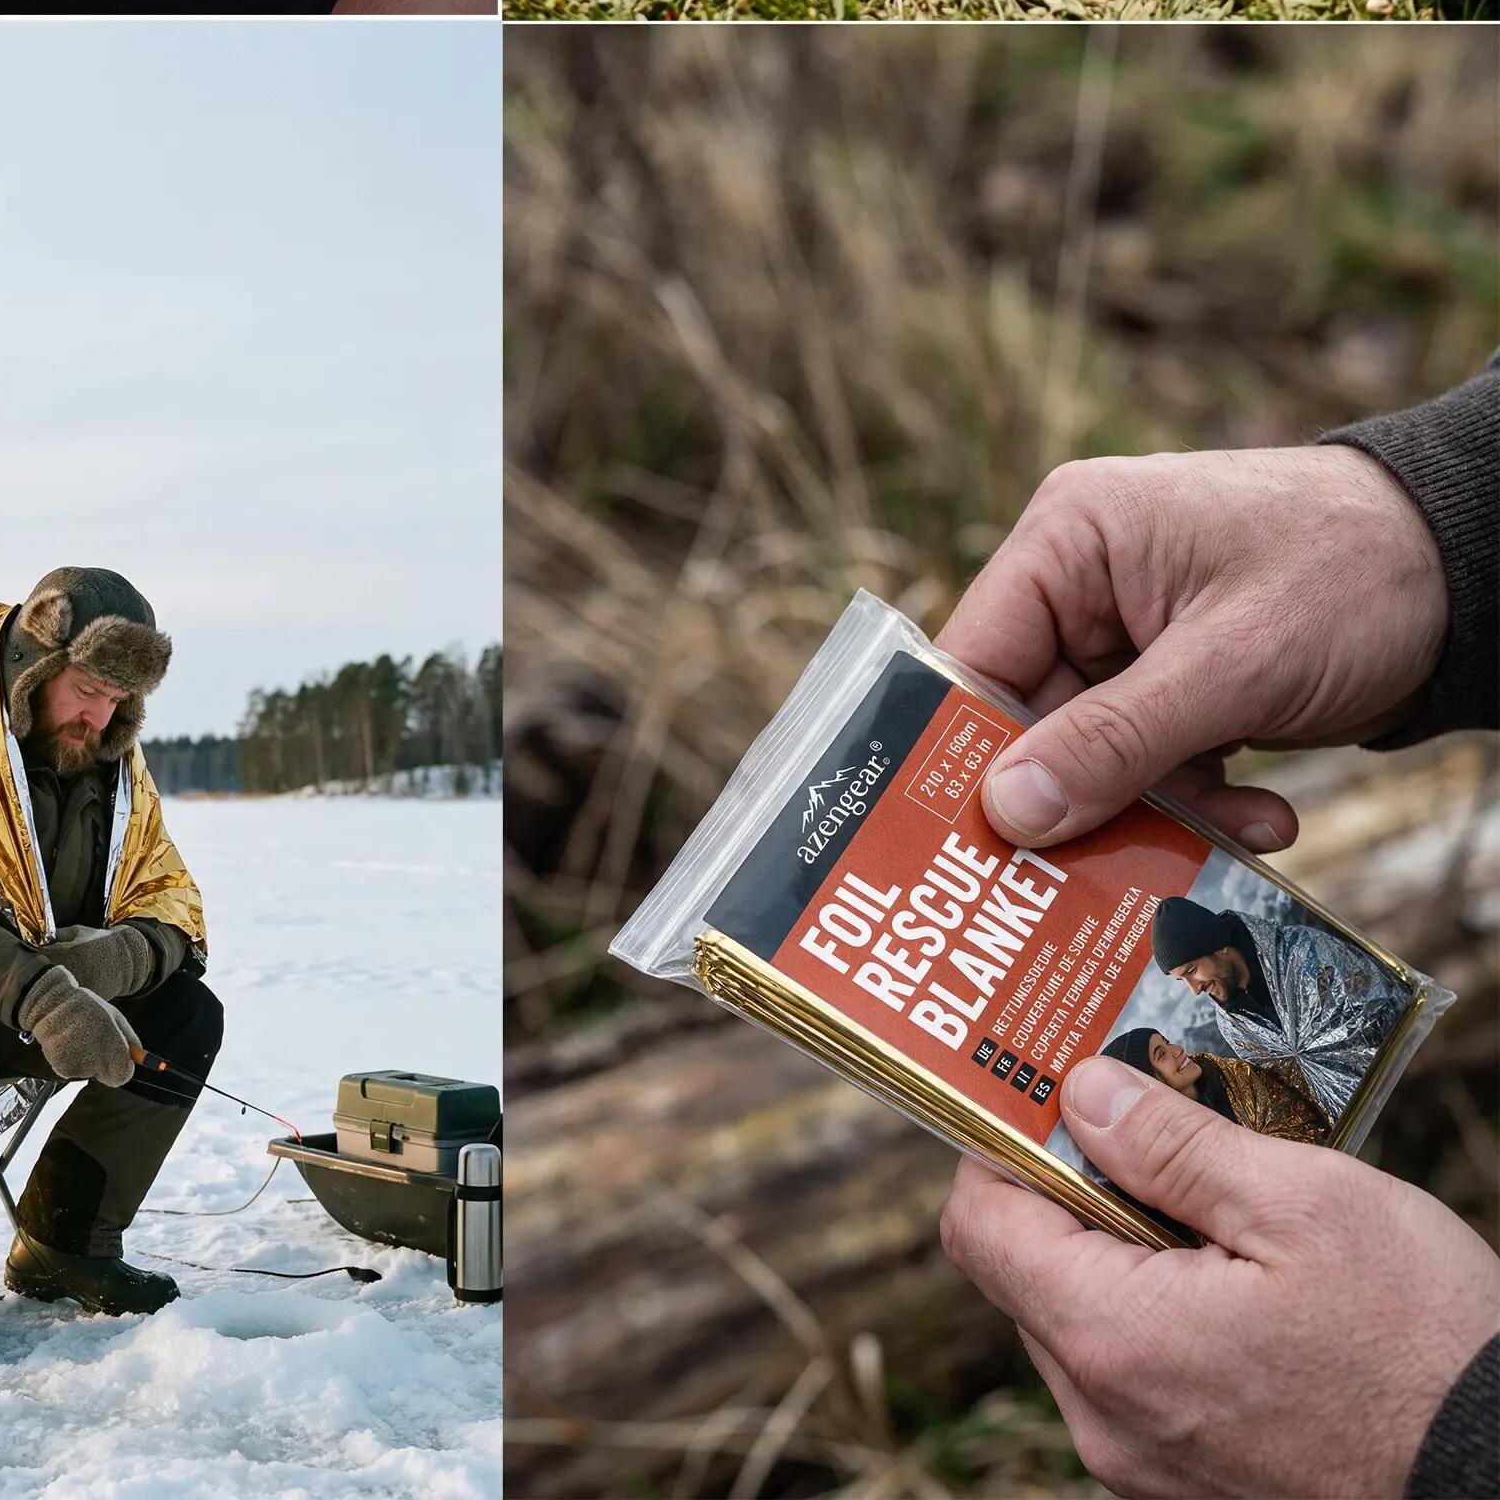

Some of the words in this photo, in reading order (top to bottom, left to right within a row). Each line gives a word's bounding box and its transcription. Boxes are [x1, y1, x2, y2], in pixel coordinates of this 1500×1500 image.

[919, 768, 943, 799] 210
[940, 758, 953, 772] x
[959, 768, 972, 780] x
[799, 871, 903, 975] FOIL
[851, 831, 1000, 1013] RESCUE
[907, 847, 1069, 1052] BLANKET
[1058, 953, 1076, 973] DE
[1068, 915, 1099, 957] SURVIE
[977, 1043, 994, 1061] DE
[1030, 1007, 1070, 1061] COPERTA
[1034, 1081, 1051, 1098] ES
[1049, 1031, 1083, 1074] MANTA
[1104, 961, 1122, 980] DE
